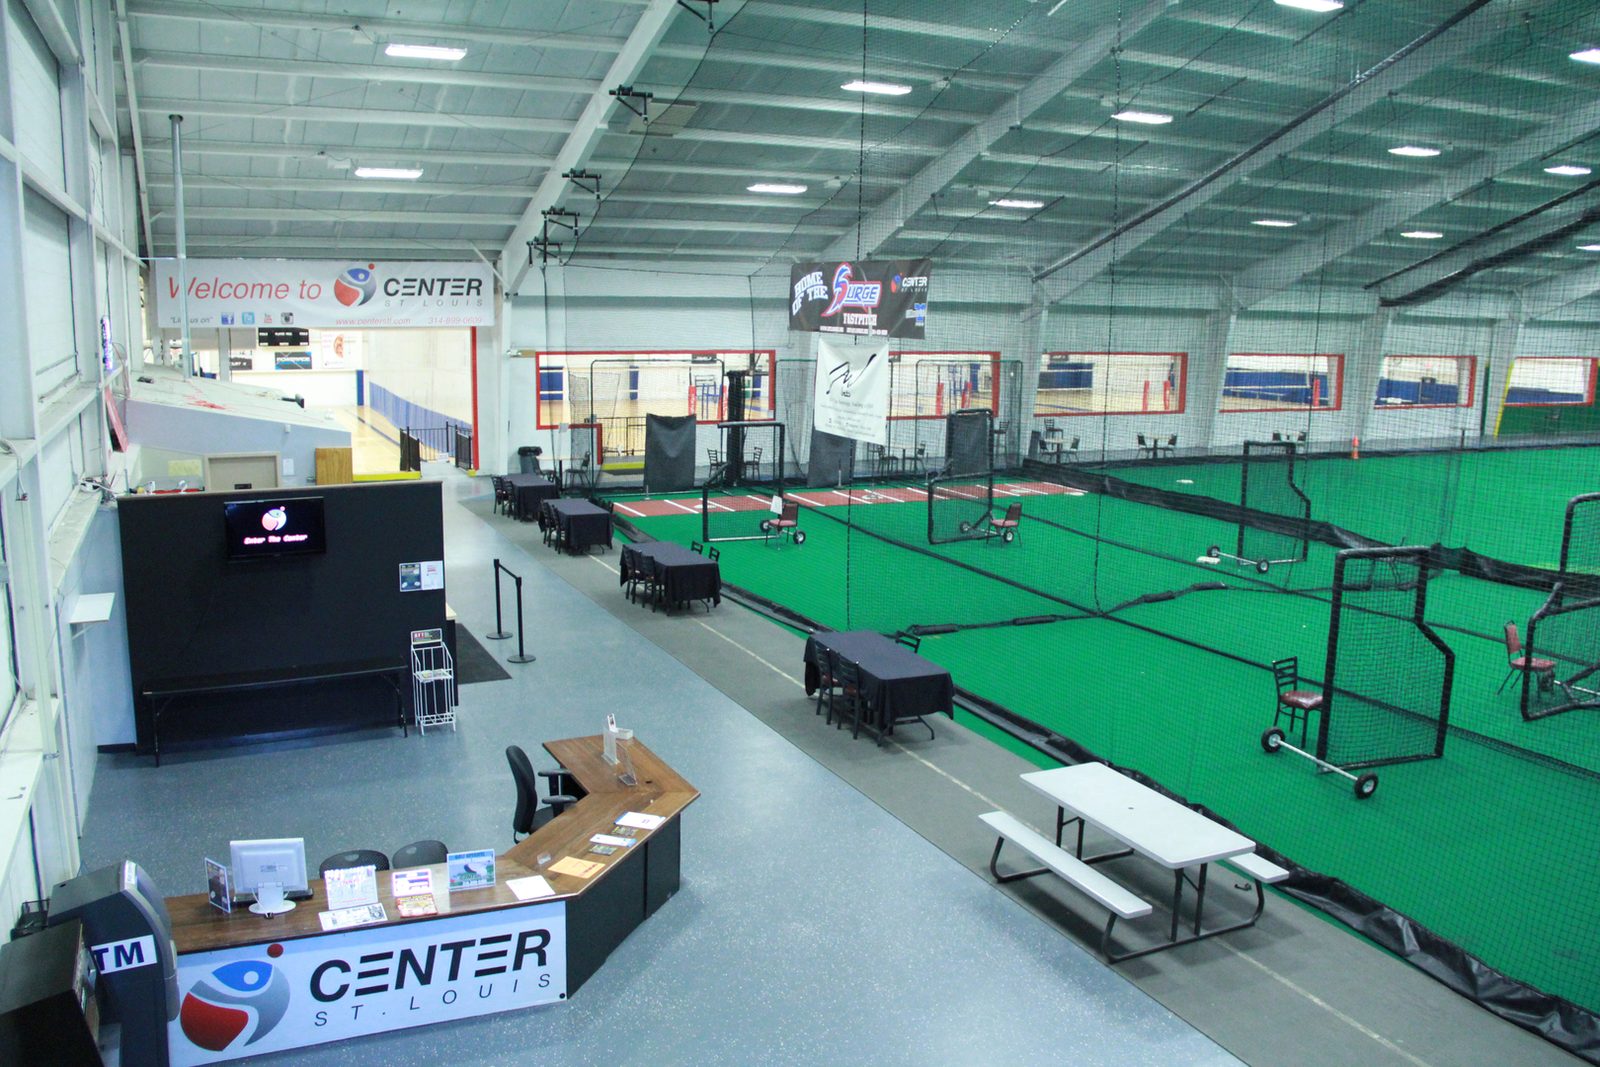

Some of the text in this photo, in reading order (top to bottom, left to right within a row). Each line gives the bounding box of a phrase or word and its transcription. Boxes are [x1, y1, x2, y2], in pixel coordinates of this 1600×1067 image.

[169, 277, 322, 299] Welcome to
[383, 278, 483, 297] CENTER
[794, 271, 823, 298] HOME
[902, 276, 928, 287] CENTER
[422, 299, 483, 307] LOUIS
[806, 285, 829, 302] THE
[93, 941, 145, 971] TM
[310, 928, 551, 1003] CENTER
[314, 973, 551, 1027] ST. LOUIS
